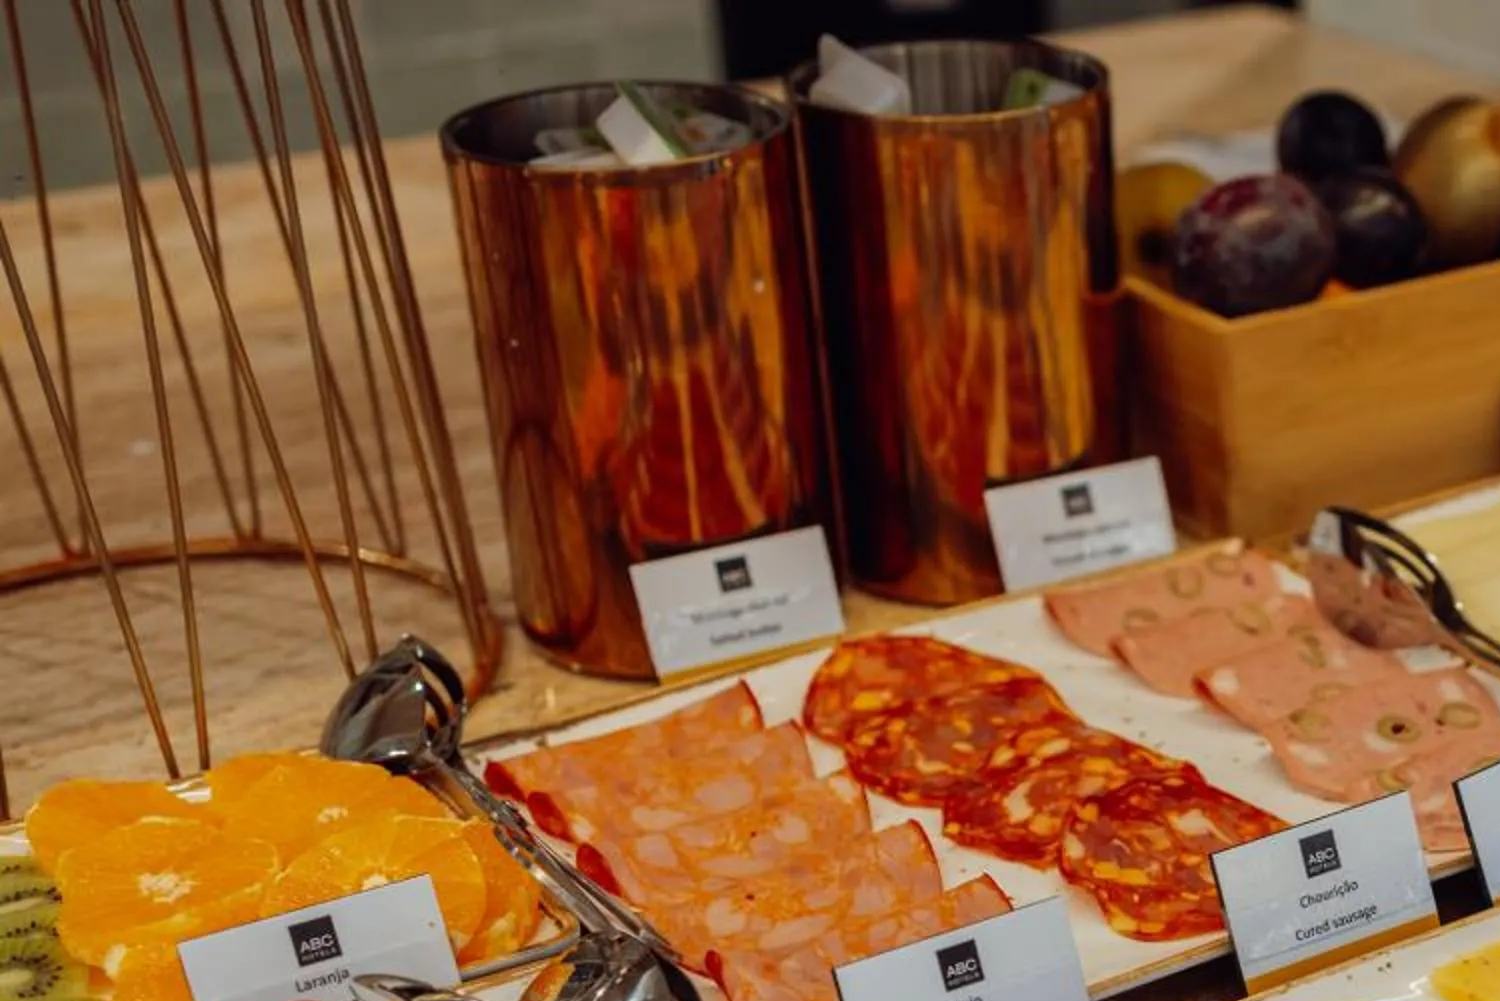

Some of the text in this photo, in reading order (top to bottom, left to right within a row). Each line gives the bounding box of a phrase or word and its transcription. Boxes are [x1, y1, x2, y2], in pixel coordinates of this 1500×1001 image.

[1308, 847, 1335, 864] ABC
[1299, 879, 1359, 909] Chourição
[1295, 905, 1378, 941] Cured sausage
[301, 933, 334, 954] ABC
[946, 958, 977, 979] ABC
[295, 969, 350, 993] Laranja
